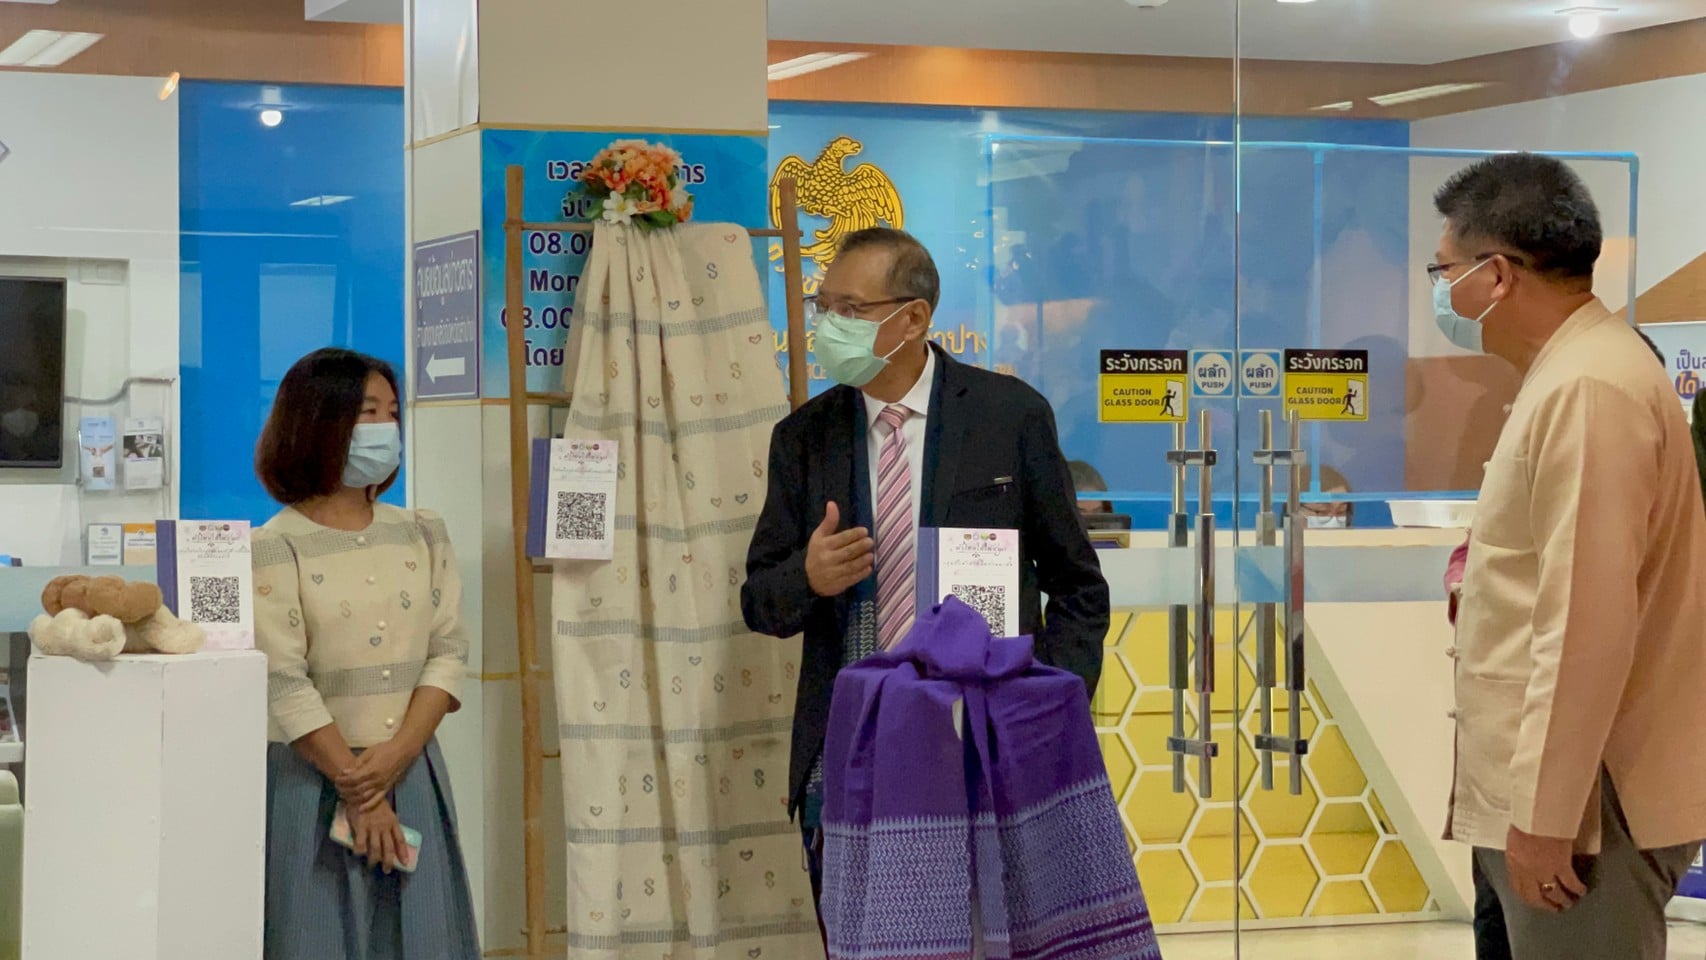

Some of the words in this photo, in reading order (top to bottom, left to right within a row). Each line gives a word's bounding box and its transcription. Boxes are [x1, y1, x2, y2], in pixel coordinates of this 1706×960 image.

[1105, 353, 1182, 372] ระวังกระจก
[1289, 352, 1364, 371] ระวังกระจก
[1197, 363, 1227, 379] ผลัก
[1246, 363, 1274, 379] ผลัก
[1201, 381, 1225, 389] PUSH
[1249, 381, 1272, 389] PUSH
[1112, 388, 1152, 396] CAUTION
[1296, 386, 1334, 395] CAUTION
[1104, 399, 1133, 407] GLASS
[1134, 399, 1161, 407] DOOR
[1288, 397, 1315, 405] GLASS
[1316, 397, 1342, 405] DOOR
